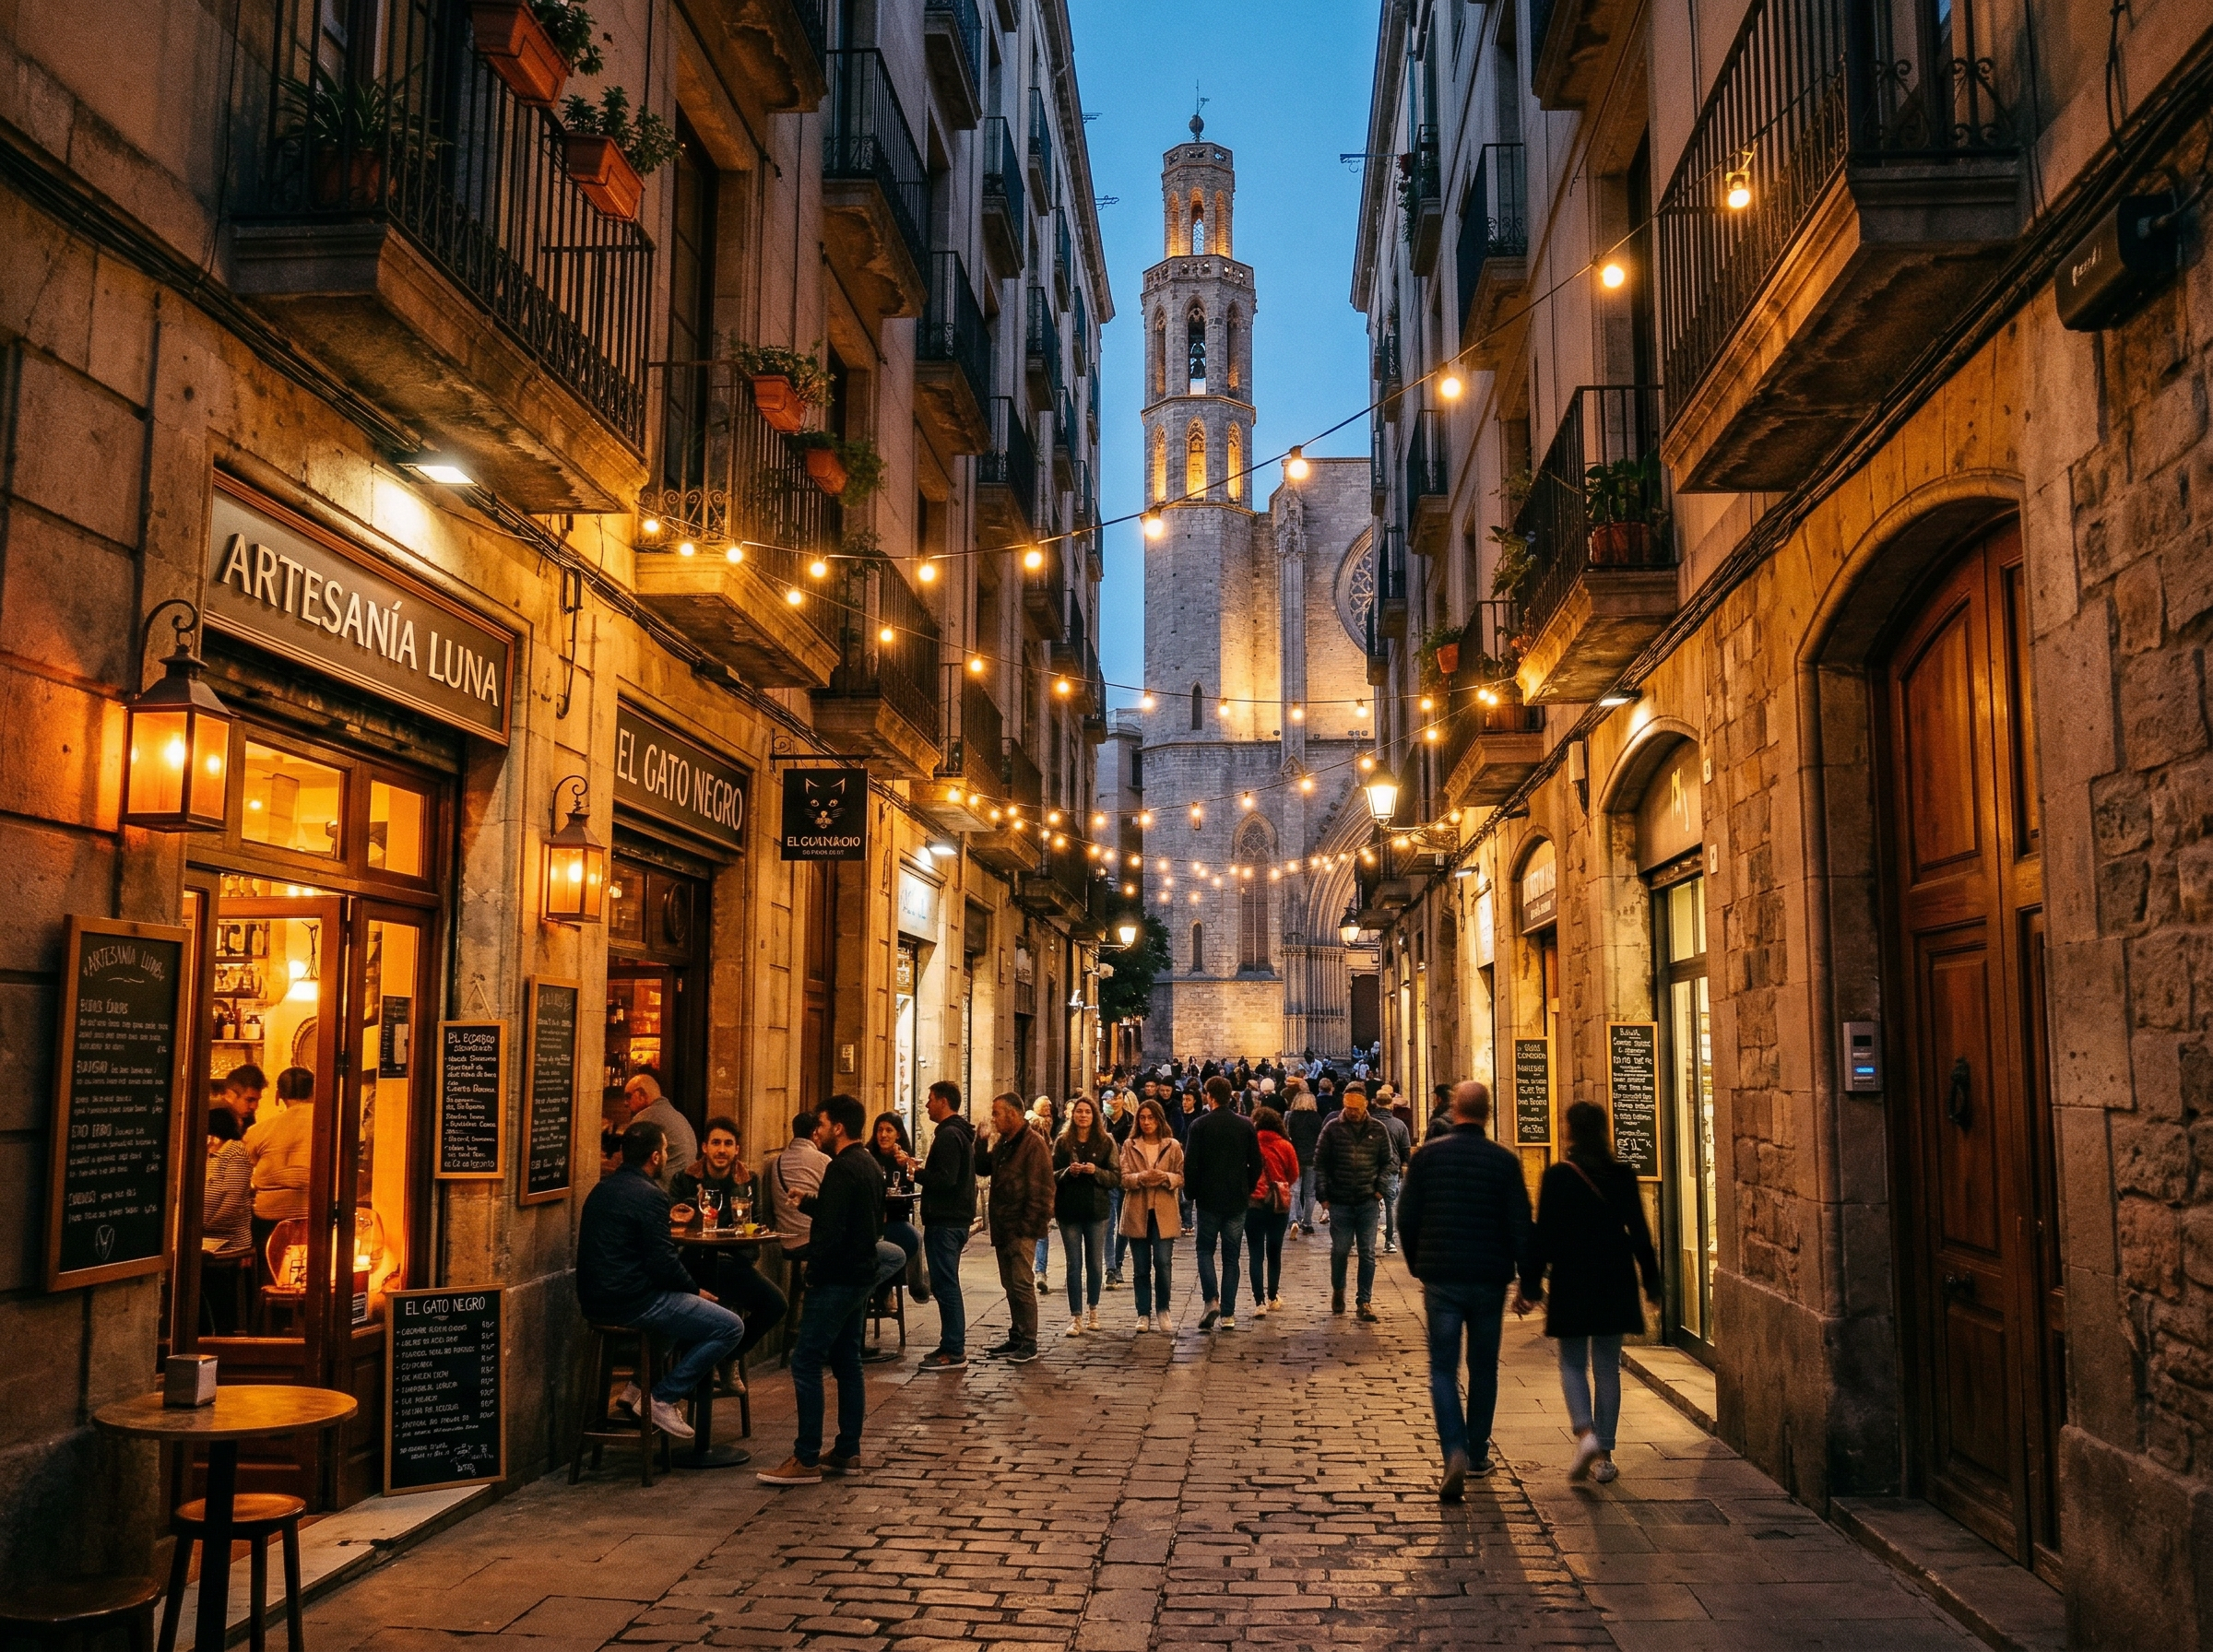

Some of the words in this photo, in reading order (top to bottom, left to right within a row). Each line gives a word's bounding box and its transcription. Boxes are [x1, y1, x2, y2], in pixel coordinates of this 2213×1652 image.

[220, 533, 418, 671] ARTESANÍA
[428, 631, 499, 707] LUNA
[617, 727, 638, 785] EL
[644, 744, 690, 807] GATO
[692, 767, 743, 831] NEGRO
[406, 1301, 420, 1316] EL
[423, 1298, 449, 1315] GATO
[453, 1296, 486, 1312] NEGRO
